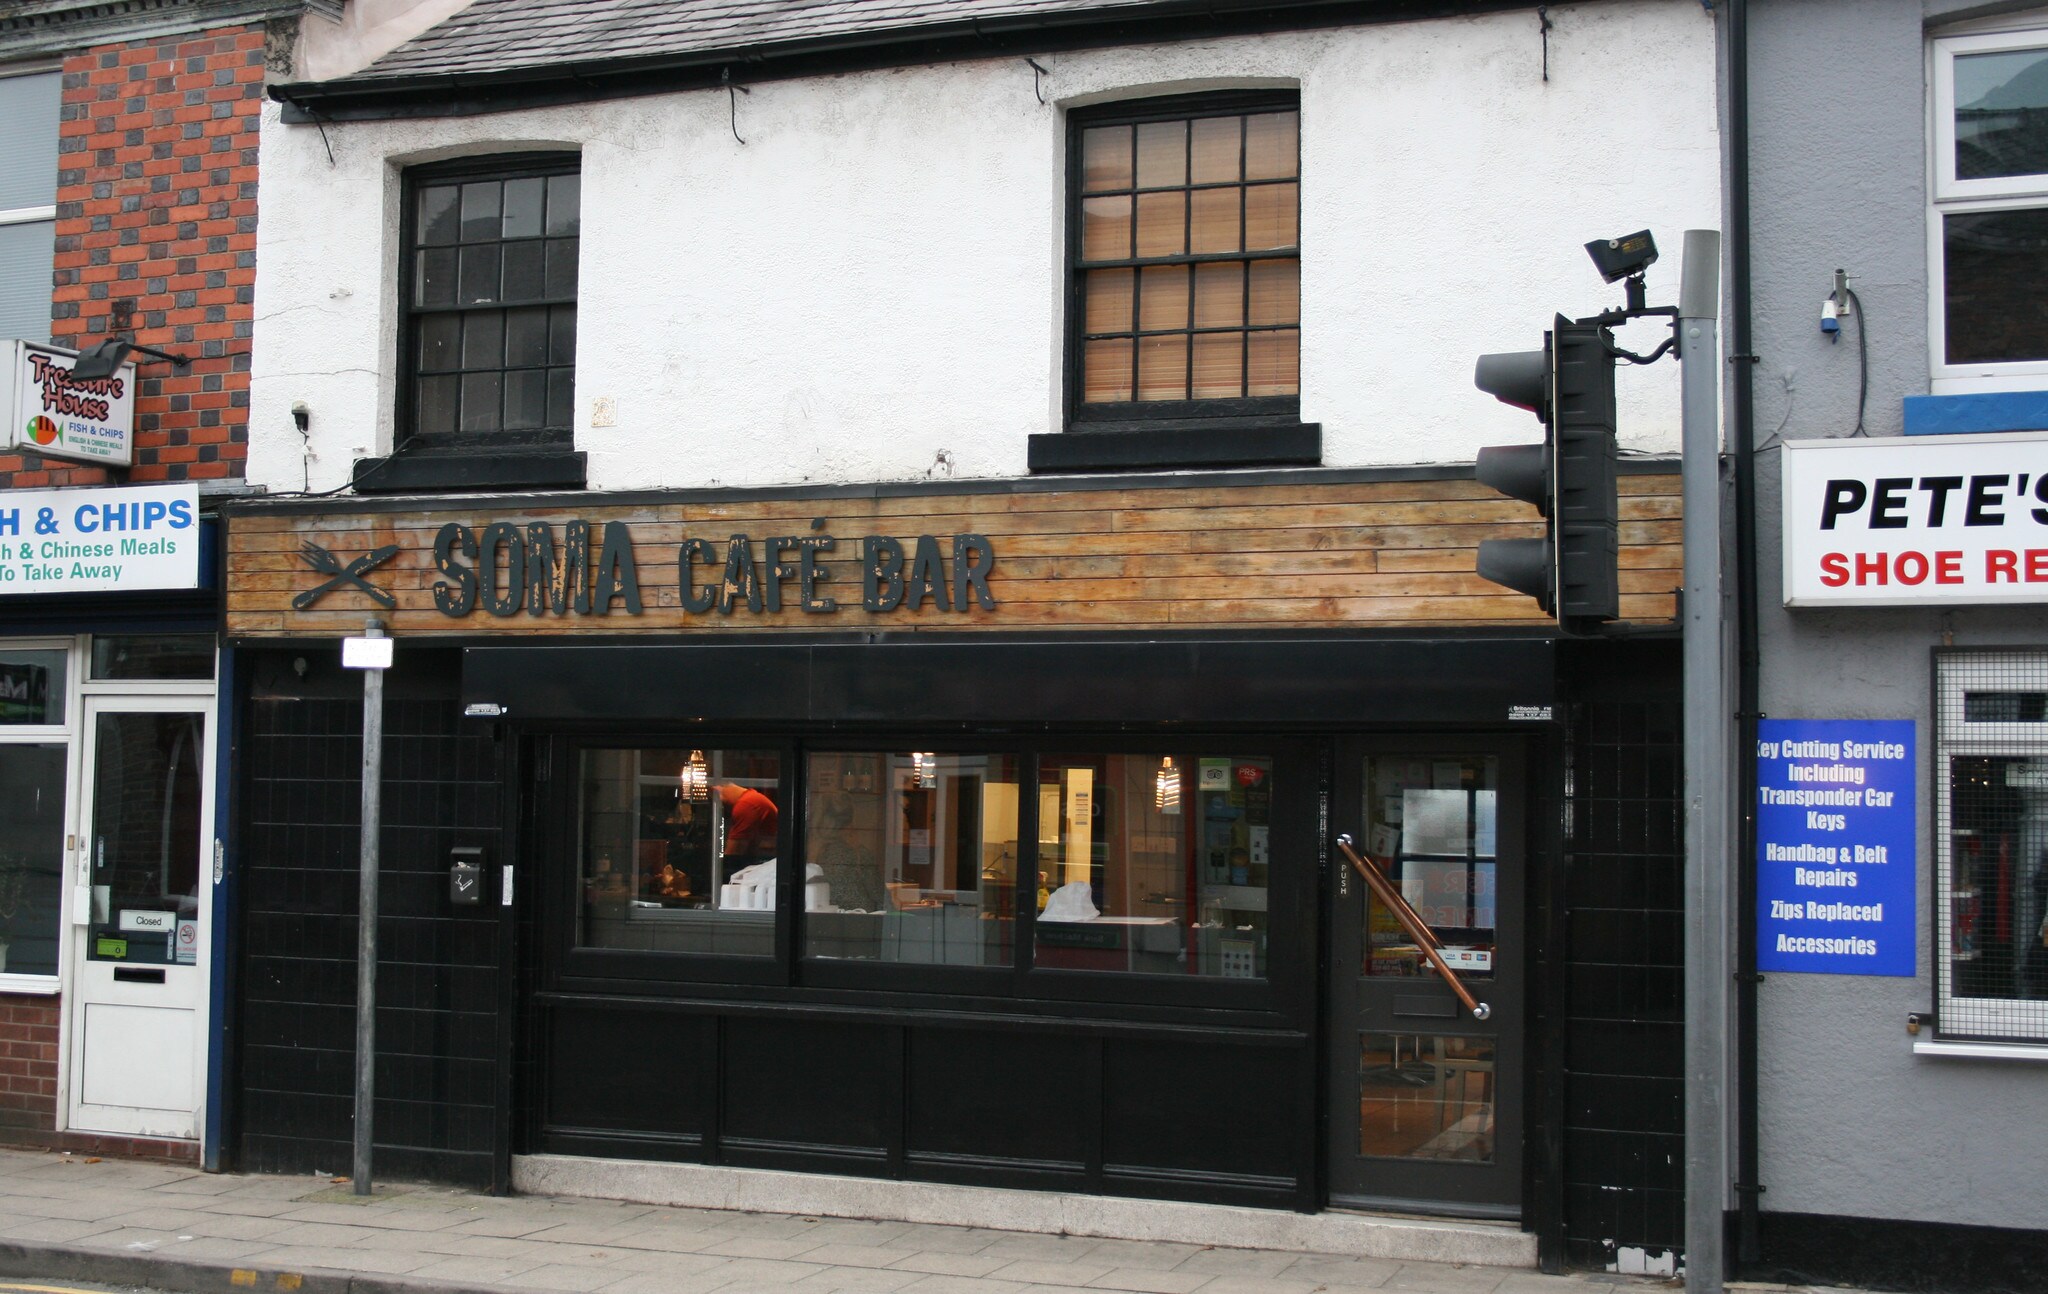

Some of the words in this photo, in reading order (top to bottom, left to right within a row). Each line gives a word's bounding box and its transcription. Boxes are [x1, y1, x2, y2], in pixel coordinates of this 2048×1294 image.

[41, 384, 109, 421] House
[69, 422, 87, 433] FISH
[90, 426, 96, 435] &
[99, 428, 124, 440] CHIPS
[35, 507, 60, 535] &
[75, 500, 192, 533] CHIPS
[20, 542, 34, 559] &
[41, 541, 114, 558] Chinese
[121, 537, 176, 556] Meals
[0, 564, 15, 581] To
[22, 563, 63, 580] Take
[70, 562, 122, 581] Away
[434, 519, 643, 617] SOMA
[679, 516, 835, 613] CAFÉ
[863, 534, 995, 611] BAR
[1819, 550, 1964, 587] SHOE
[1757, 740, 1779, 760] ey
[1782, 740, 1839, 760] Cutting
[1843, 740, 1904, 759] Service
[1239, 767, 1256, 776] PRS
[1788, 764, 1864, 784] Including
[1760, 787, 1862, 807] Transponder
[1865, 788, 1894, 806] Car
[1807, 811, 1845, 831] Keys
[1766, 843, 1836, 864] Handbag
[1840, 847, 1851, 863] &
[1855, 845, 1887, 863] Belt
[1795, 867, 1857, 887] Repairs
[136, 916, 162, 926] Closed
[1771, 901, 1803, 920] Zips
[1807, 901, 1883, 921] Replaced
[1777, 934, 1877, 955] Accessories
